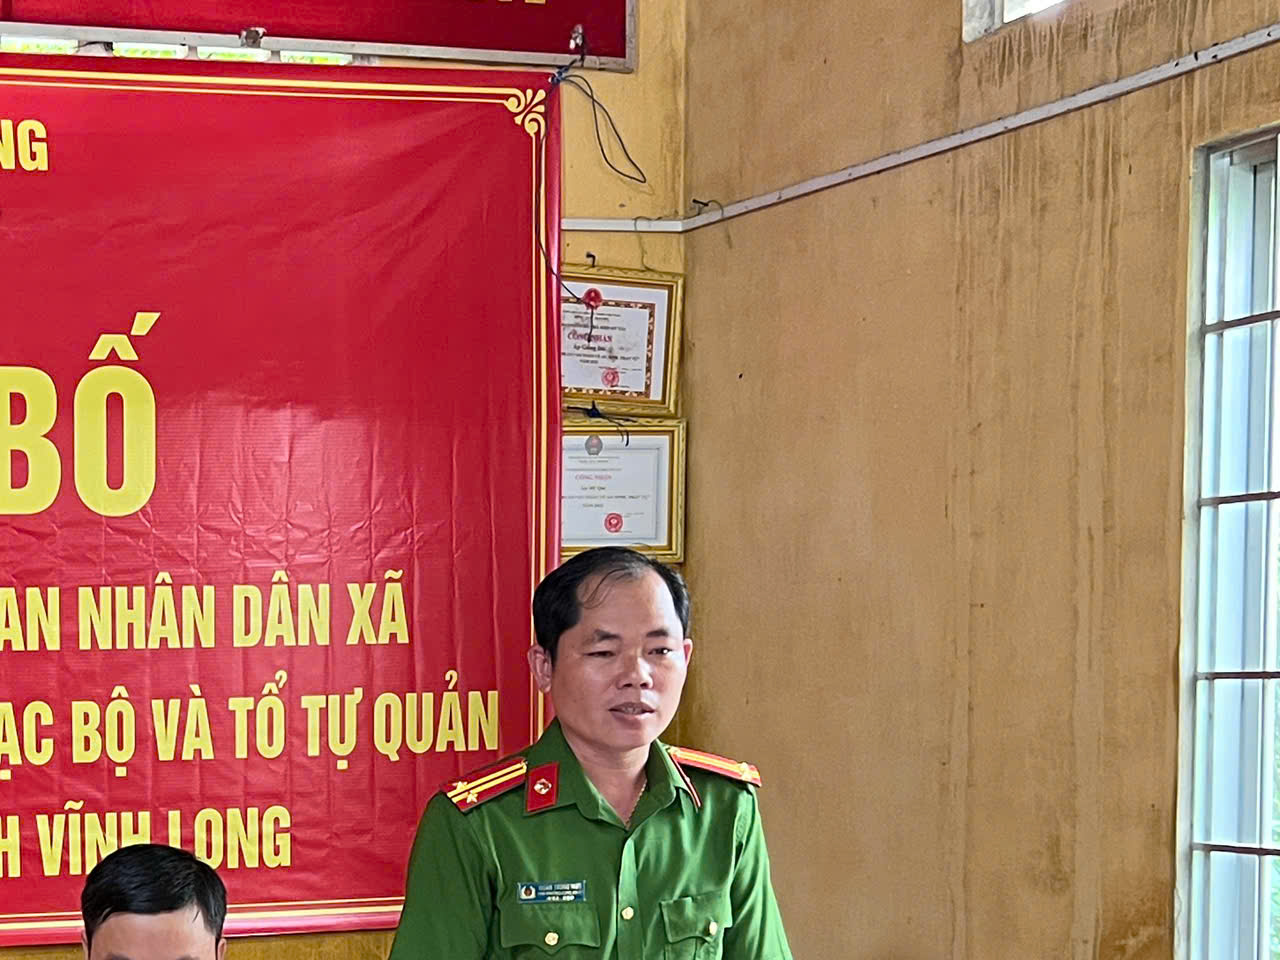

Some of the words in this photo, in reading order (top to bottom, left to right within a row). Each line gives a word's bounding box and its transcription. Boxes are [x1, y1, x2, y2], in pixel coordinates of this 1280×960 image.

[78, 571, 216, 650] NHÂN
[232, 570, 331, 648] DÂN
[347, 569, 410, 645] XÃ
[71, 685, 136, 777] BỘ
[151, 684, 216, 762] VÀ
[227, 670, 287, 760] TỔ
[300, 686, 365, 769] TỰ
[374, 670, 500, 763] QUẢN
[36, 799, 152, 877] VĨNH
